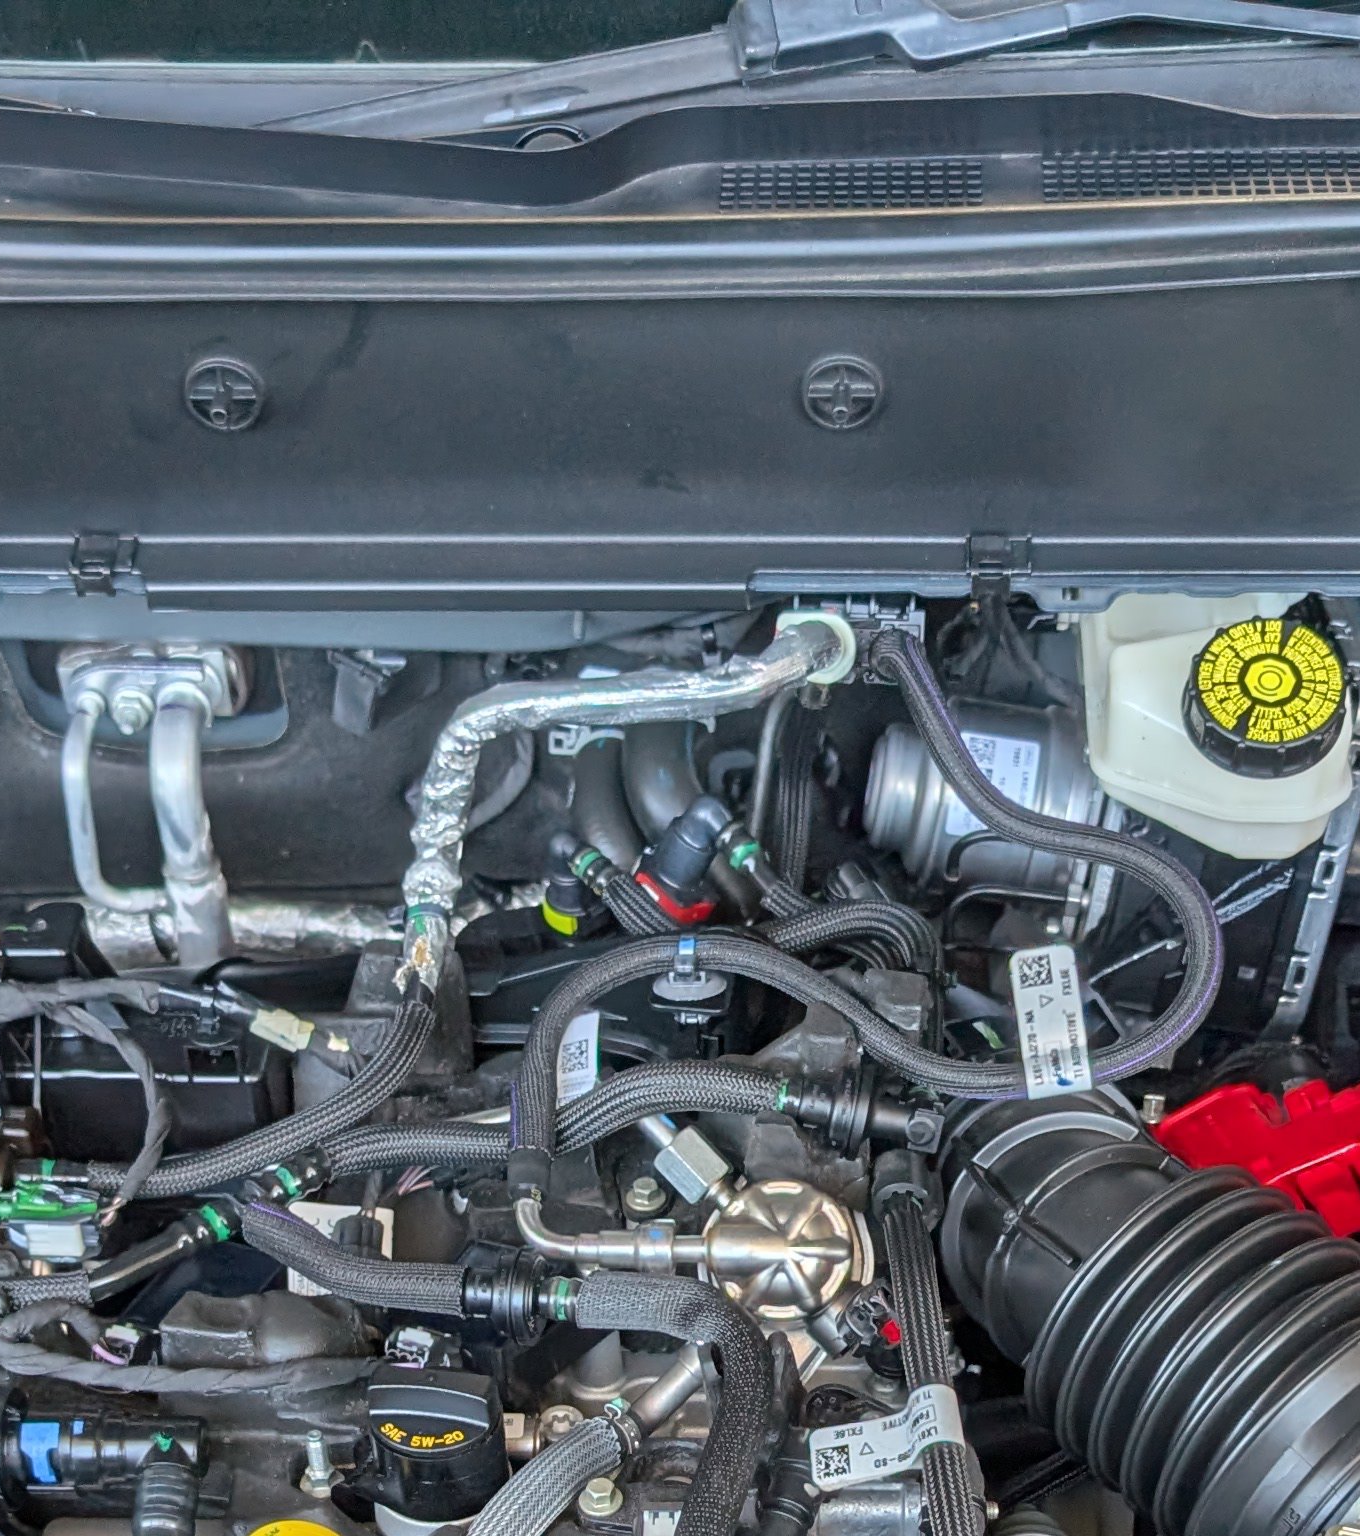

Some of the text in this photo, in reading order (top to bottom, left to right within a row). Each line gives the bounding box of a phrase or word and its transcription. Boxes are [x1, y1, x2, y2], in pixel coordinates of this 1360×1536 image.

[1227, 621, 1254, 640] FLUID
[1263, 619, 1282, 631] DOT
[1207, 633, 1233, 655] FROM
[1281, 722, 1309, 740] AVANT
[380, 1422, 465, 1448] SAE 5W-20
